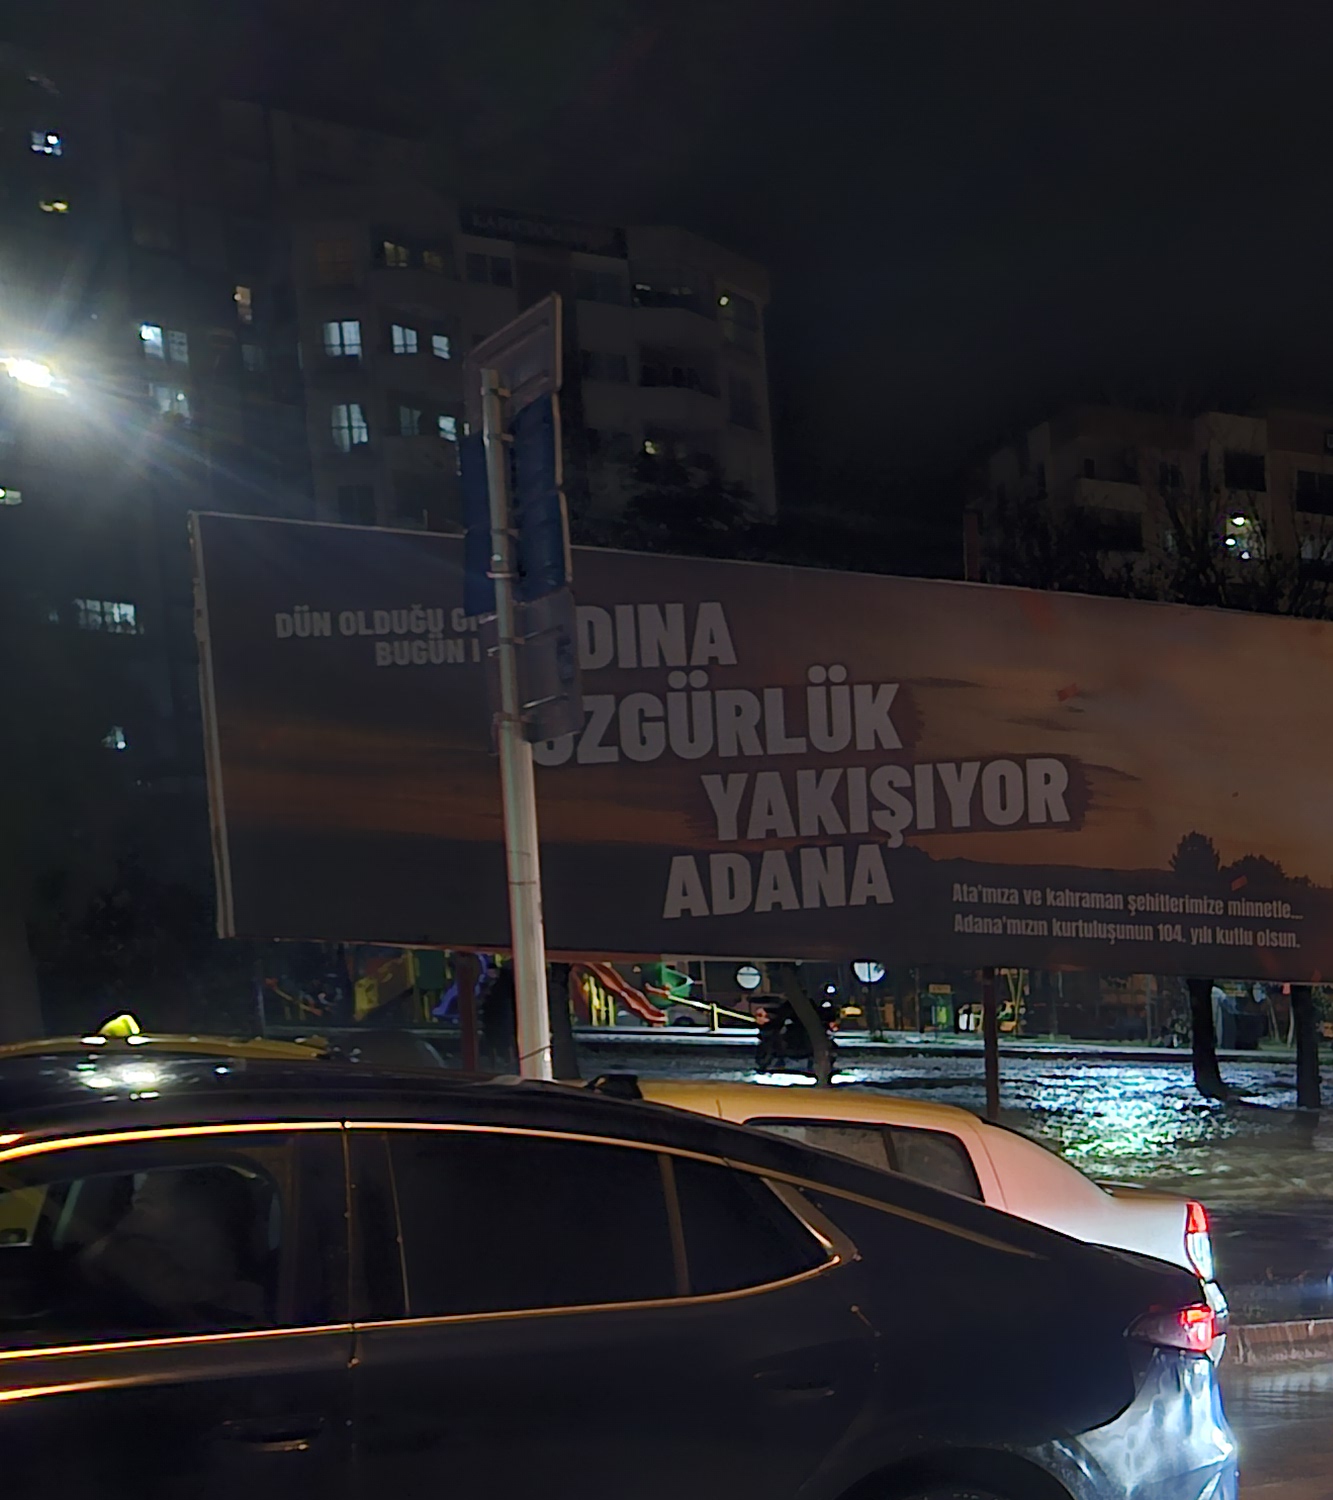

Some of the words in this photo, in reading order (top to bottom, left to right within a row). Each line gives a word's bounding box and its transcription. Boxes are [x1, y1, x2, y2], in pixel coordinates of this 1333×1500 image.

[275, 605, 332, 638] DÜN
[339, 603, 444, 635] OLDUĞU
[576, 602, 738, 669] DINA
[376, 633, 465, 667] BUGÜN
[701, 757, 1070, 848] YAKIŞIYOR
[662, 843, 894, 919] ADANA
[953, 883, 1019, 905] Ata'mıza
[1023, 888, 1042, 906] ve
[1046, 887, 1124, 910] kahraman
[1127, 893, 1224, 917] şehitlerimize
[954, 914, 1048, 936] Adana'mızın
[1052, 918, 1154, 945] kurtuluşunun
[1157, 923, 1187, 943] 104.
[1190, 926, 1212, 945] yılı
[1216, 926, 1253, 946] kutlu
[1257, 929, 1301, 948] olsun.
